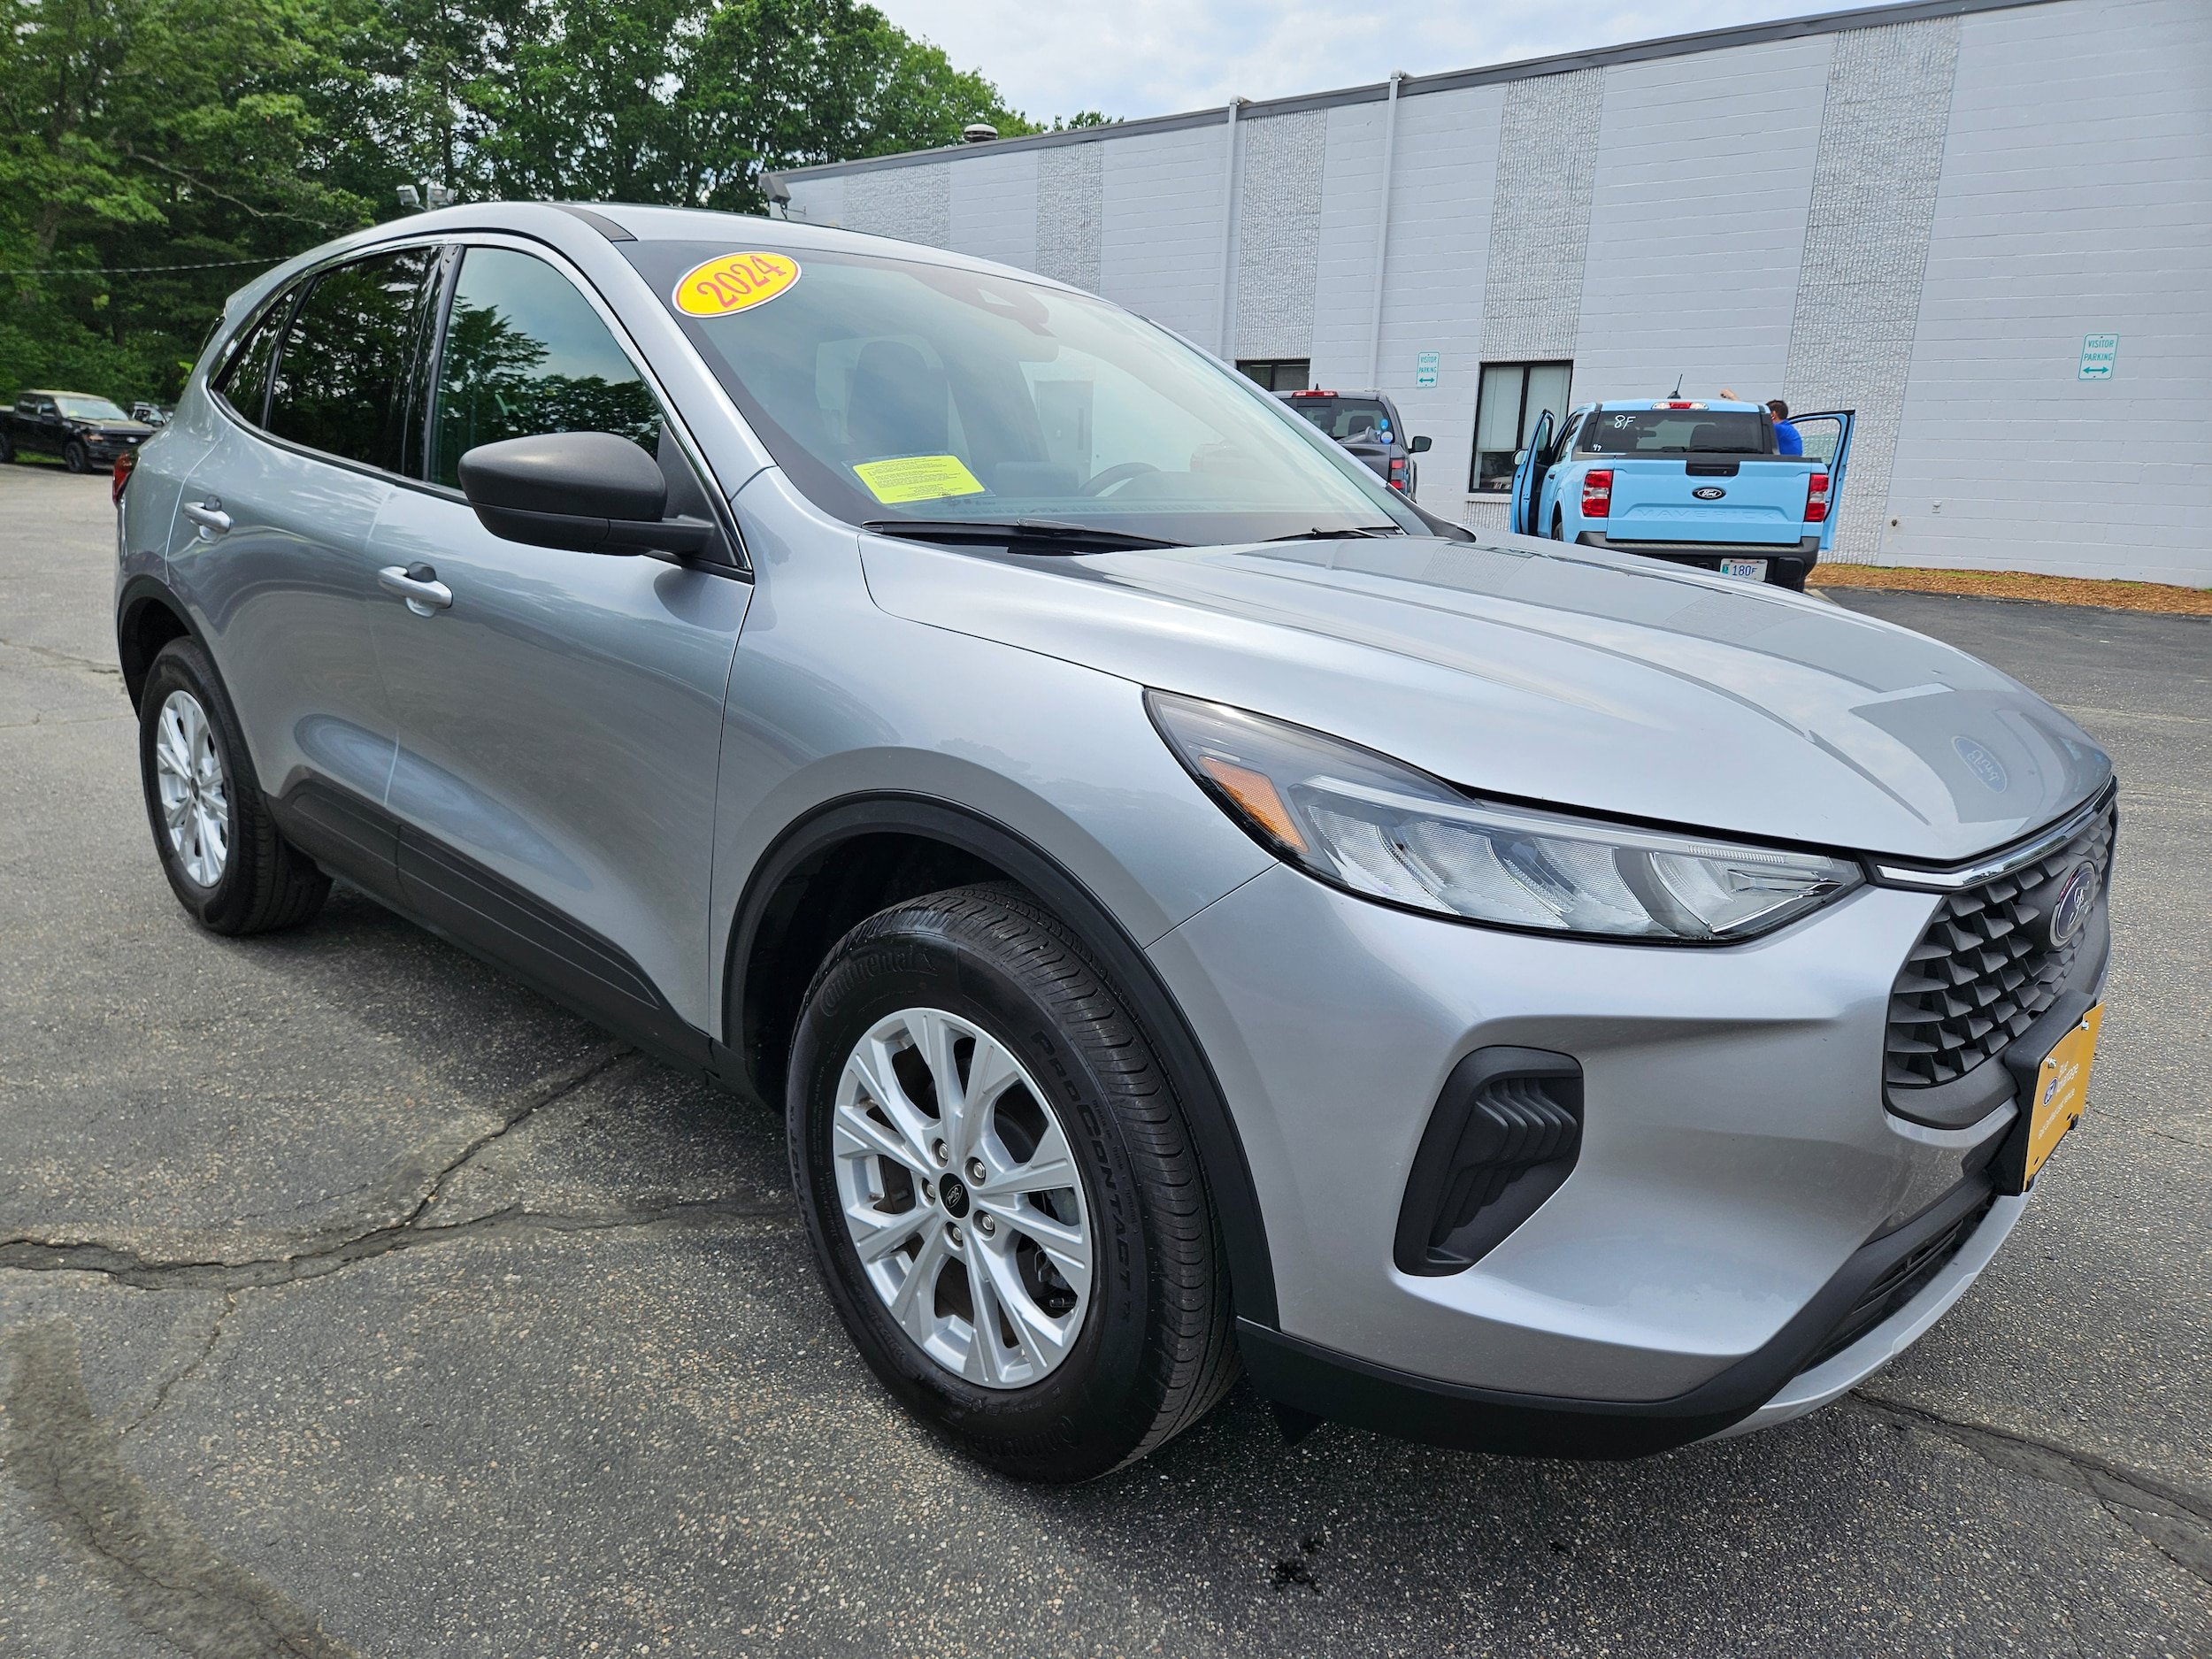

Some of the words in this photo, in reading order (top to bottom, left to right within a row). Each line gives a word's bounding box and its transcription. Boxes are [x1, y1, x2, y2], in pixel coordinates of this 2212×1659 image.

[696, 255, 787, 308] 2024
[2088, 339, 2114, 348] VISITOR
[1614, 414, 1637, 430] 8F
